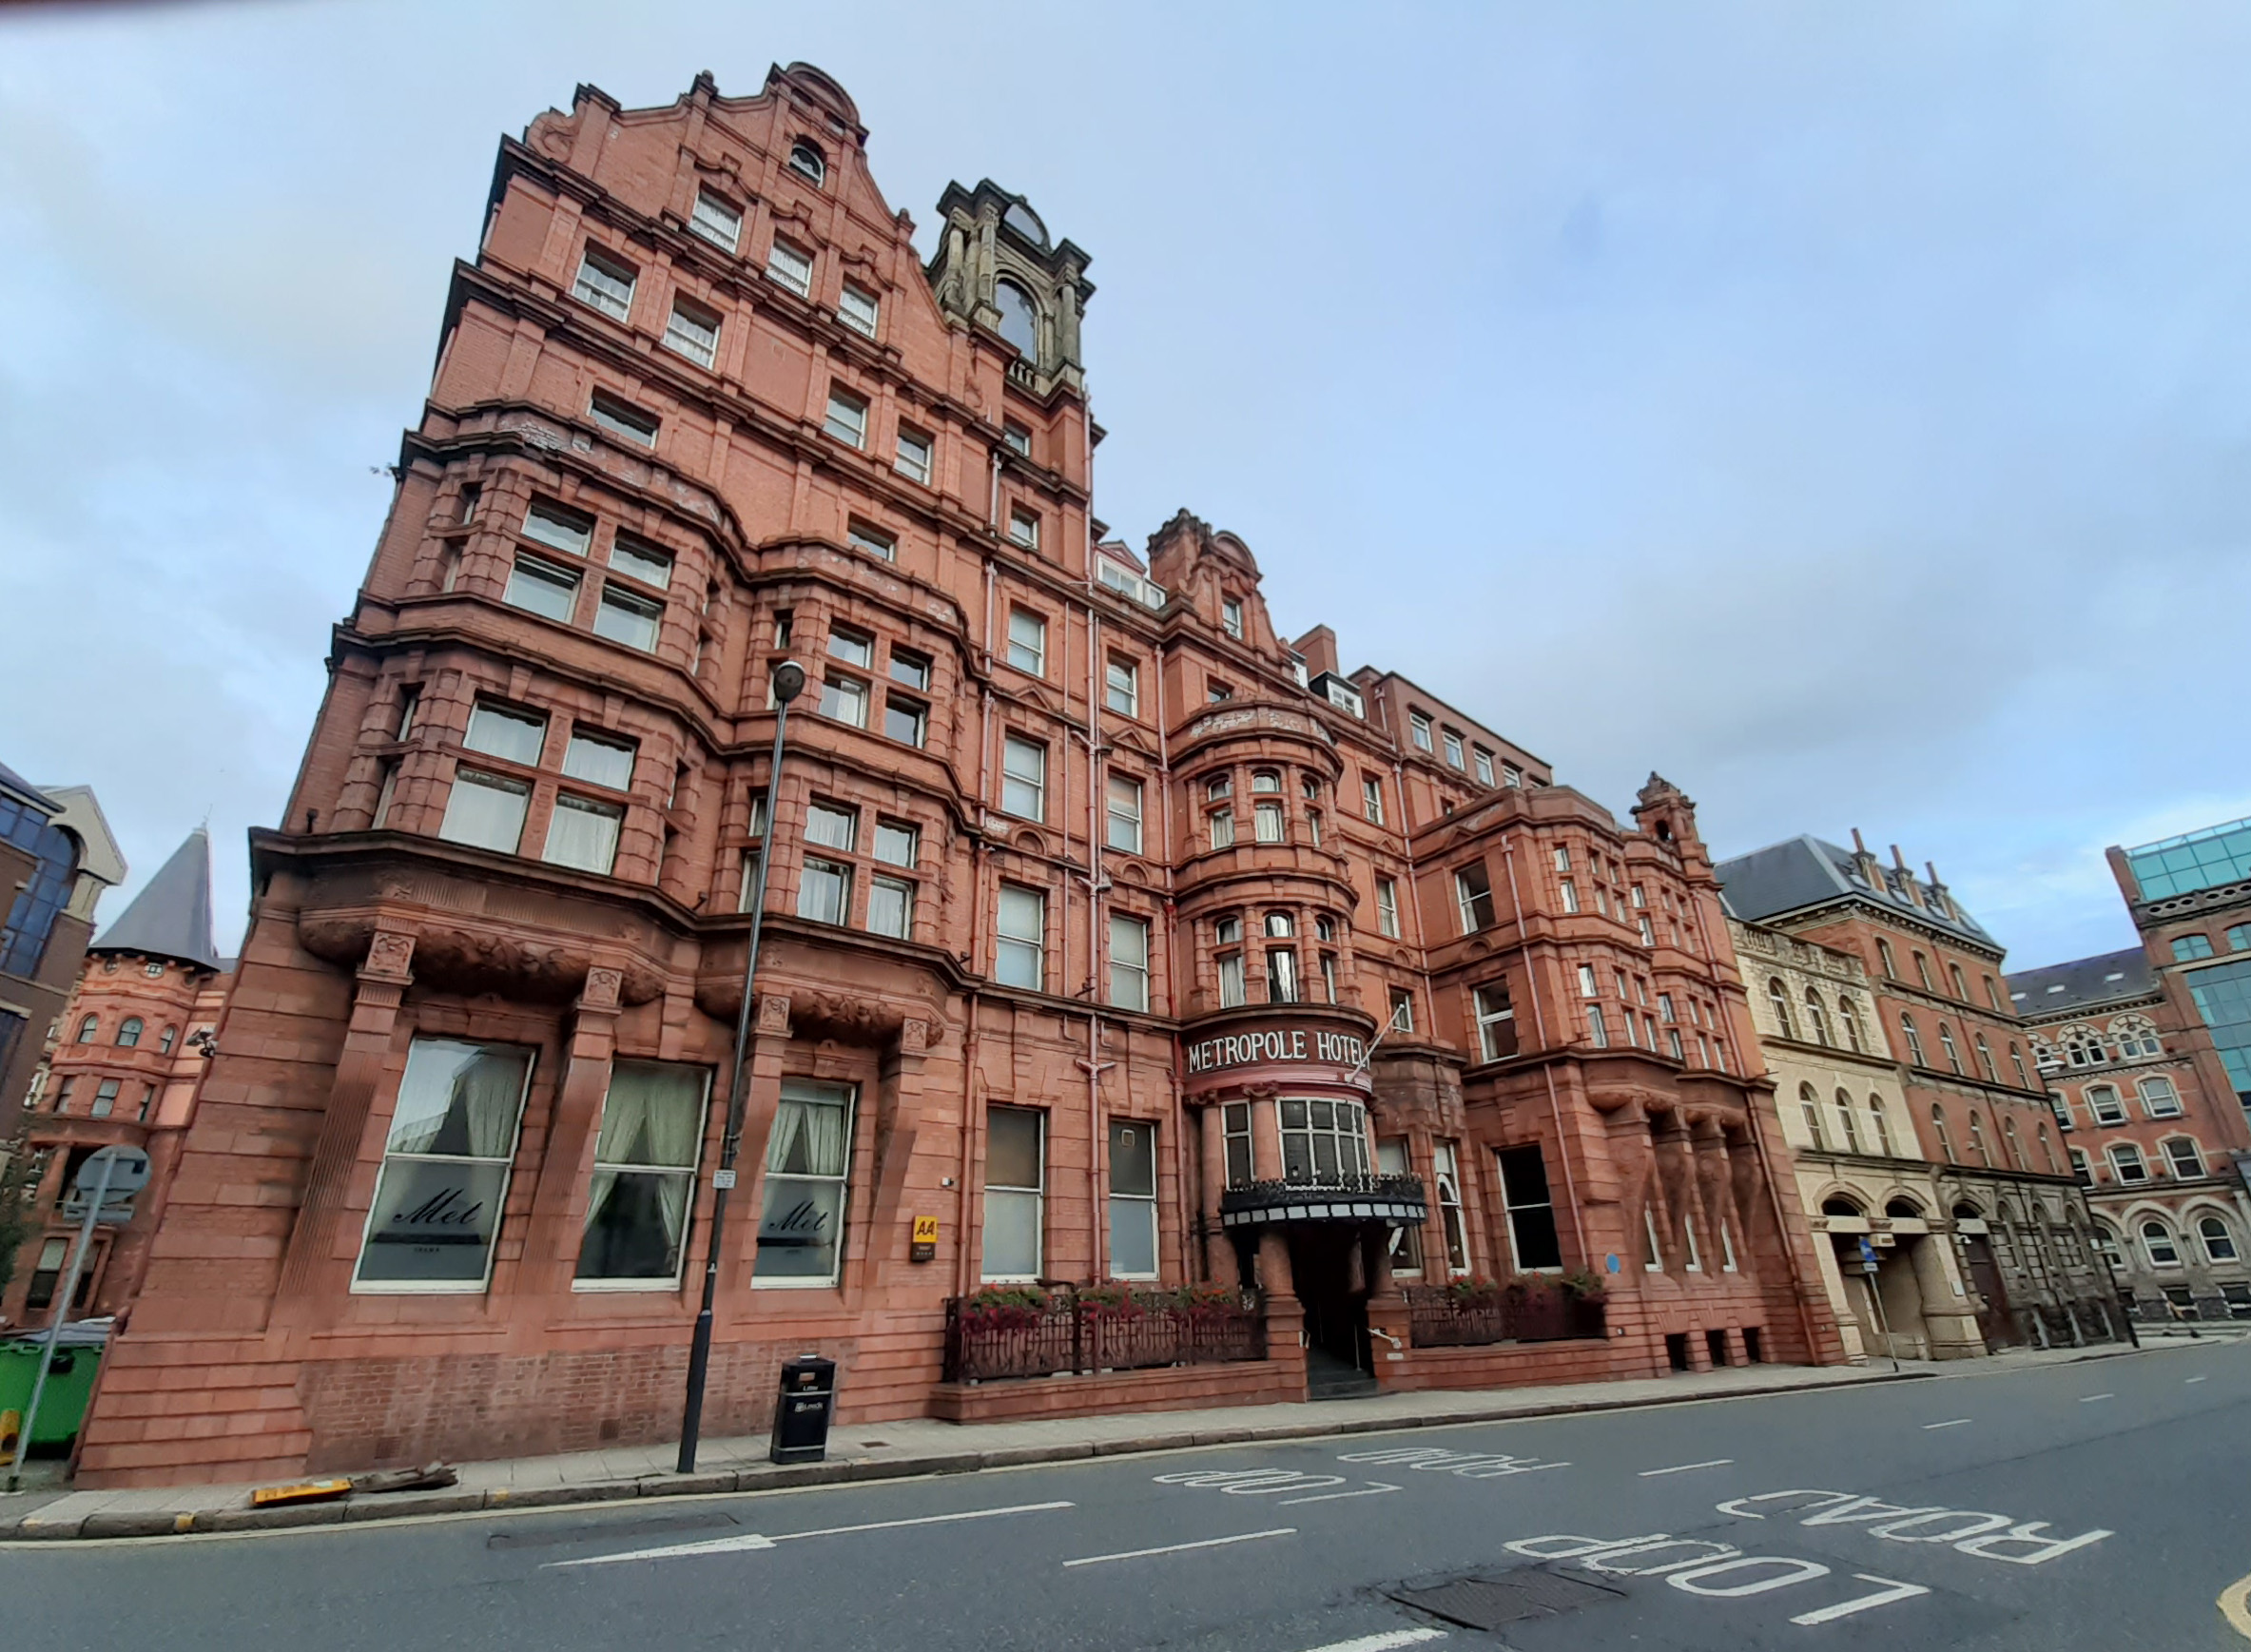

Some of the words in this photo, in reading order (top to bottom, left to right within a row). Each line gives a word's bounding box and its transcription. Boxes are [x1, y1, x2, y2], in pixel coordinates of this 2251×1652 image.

[1189, 1030, 1308, 1074] METROPOLE
[1317, 1032, 1367, 1068] HOTEL
[393, 1187, 483, 1225] Met
[767, 1200, 828, 1232] Met
[916, 1220, 936, 1235] AA
[1152, 1467, 1403, 1506] LOOP
[1716, 1489, 2116, 1565] ROAD
[1502, 1533, 1931, 1625] LOOP
